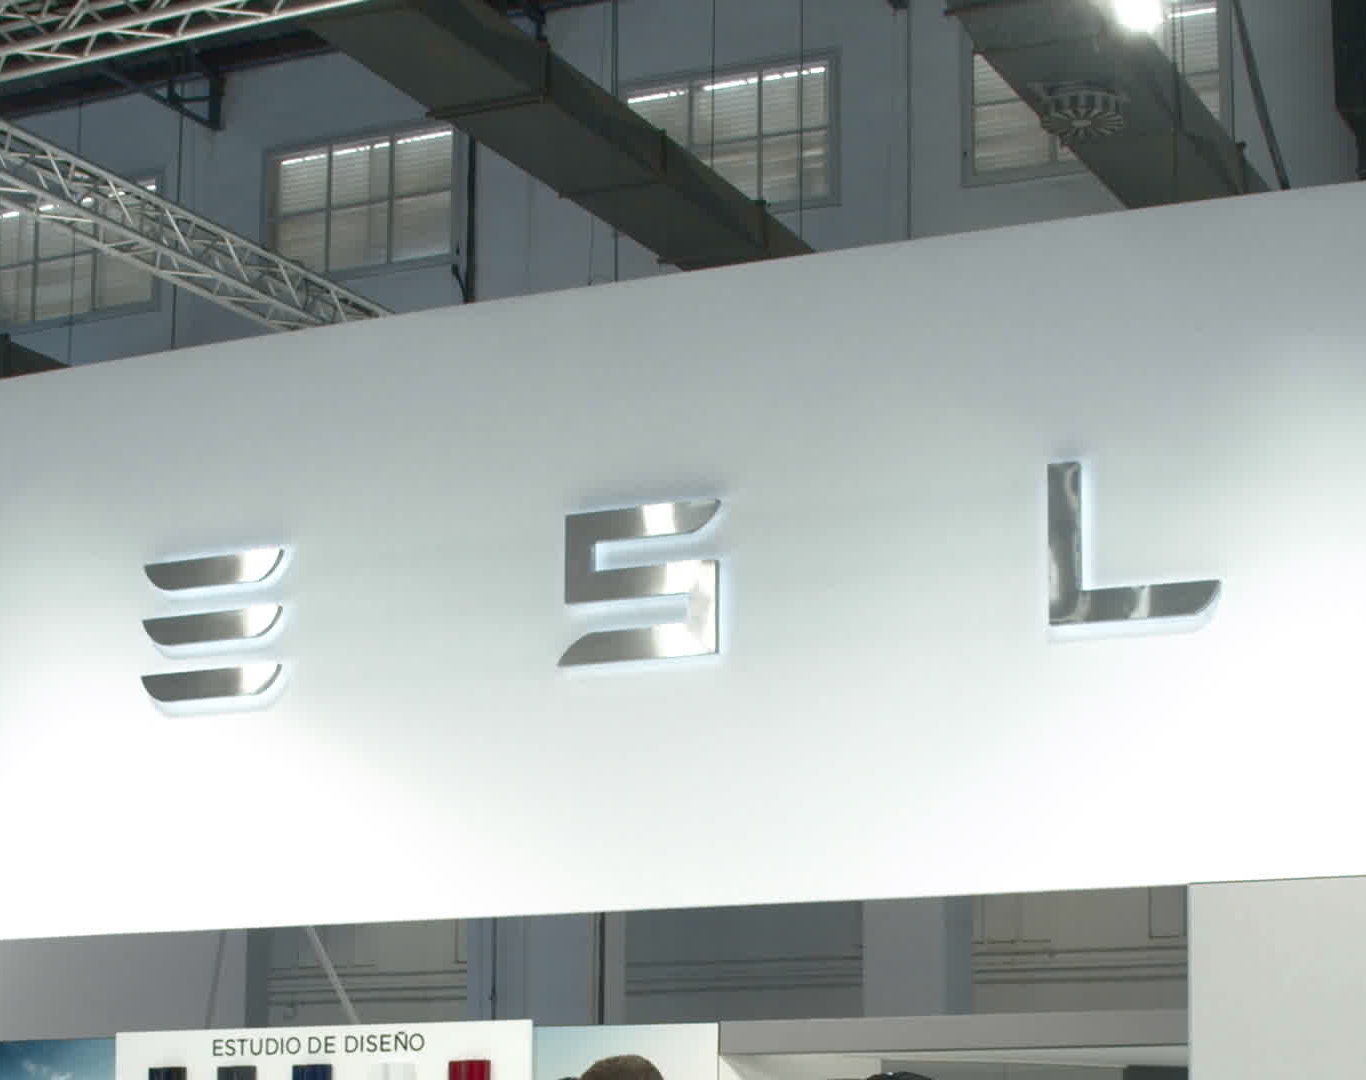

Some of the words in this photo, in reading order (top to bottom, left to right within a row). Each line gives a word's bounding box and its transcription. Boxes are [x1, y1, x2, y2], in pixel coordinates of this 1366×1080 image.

[212, 1036, 301, 1057] ESTUDIO
[308, 1036, 336, 1054] DE
[345, 1032, 425, 1053] DISEÑO
